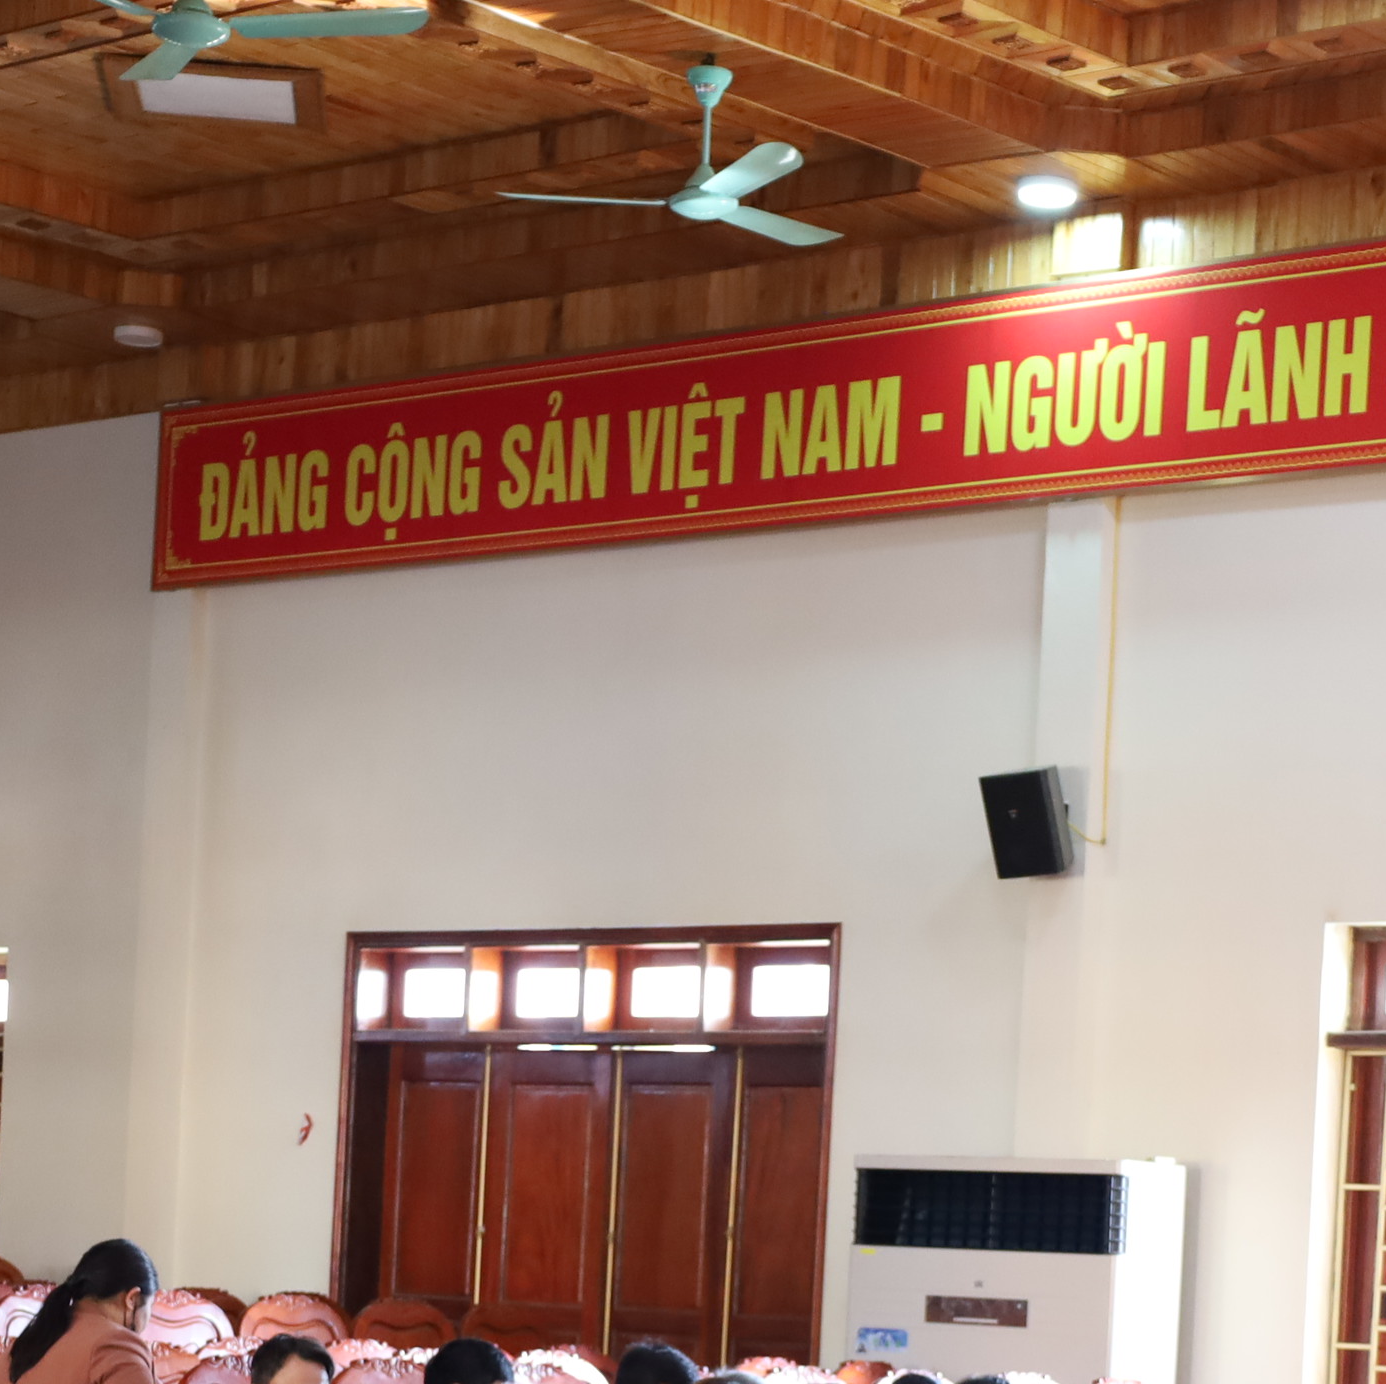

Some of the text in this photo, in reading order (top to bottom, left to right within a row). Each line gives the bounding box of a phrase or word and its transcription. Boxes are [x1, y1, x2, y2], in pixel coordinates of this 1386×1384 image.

[199, 431, 328, 541] ĐẢNG
[344, 422, 481, 541] CỘNG
[498, 391, 610, 509] SẢN
[628, 383, 745, 509] VIỆT
[760, 376, 902, 480] NAM
[920, 412, 945, 433] -
[962, 321, 1169, 458] NGƯỜI
[1185, 309, 1373, 433] LÃNH
